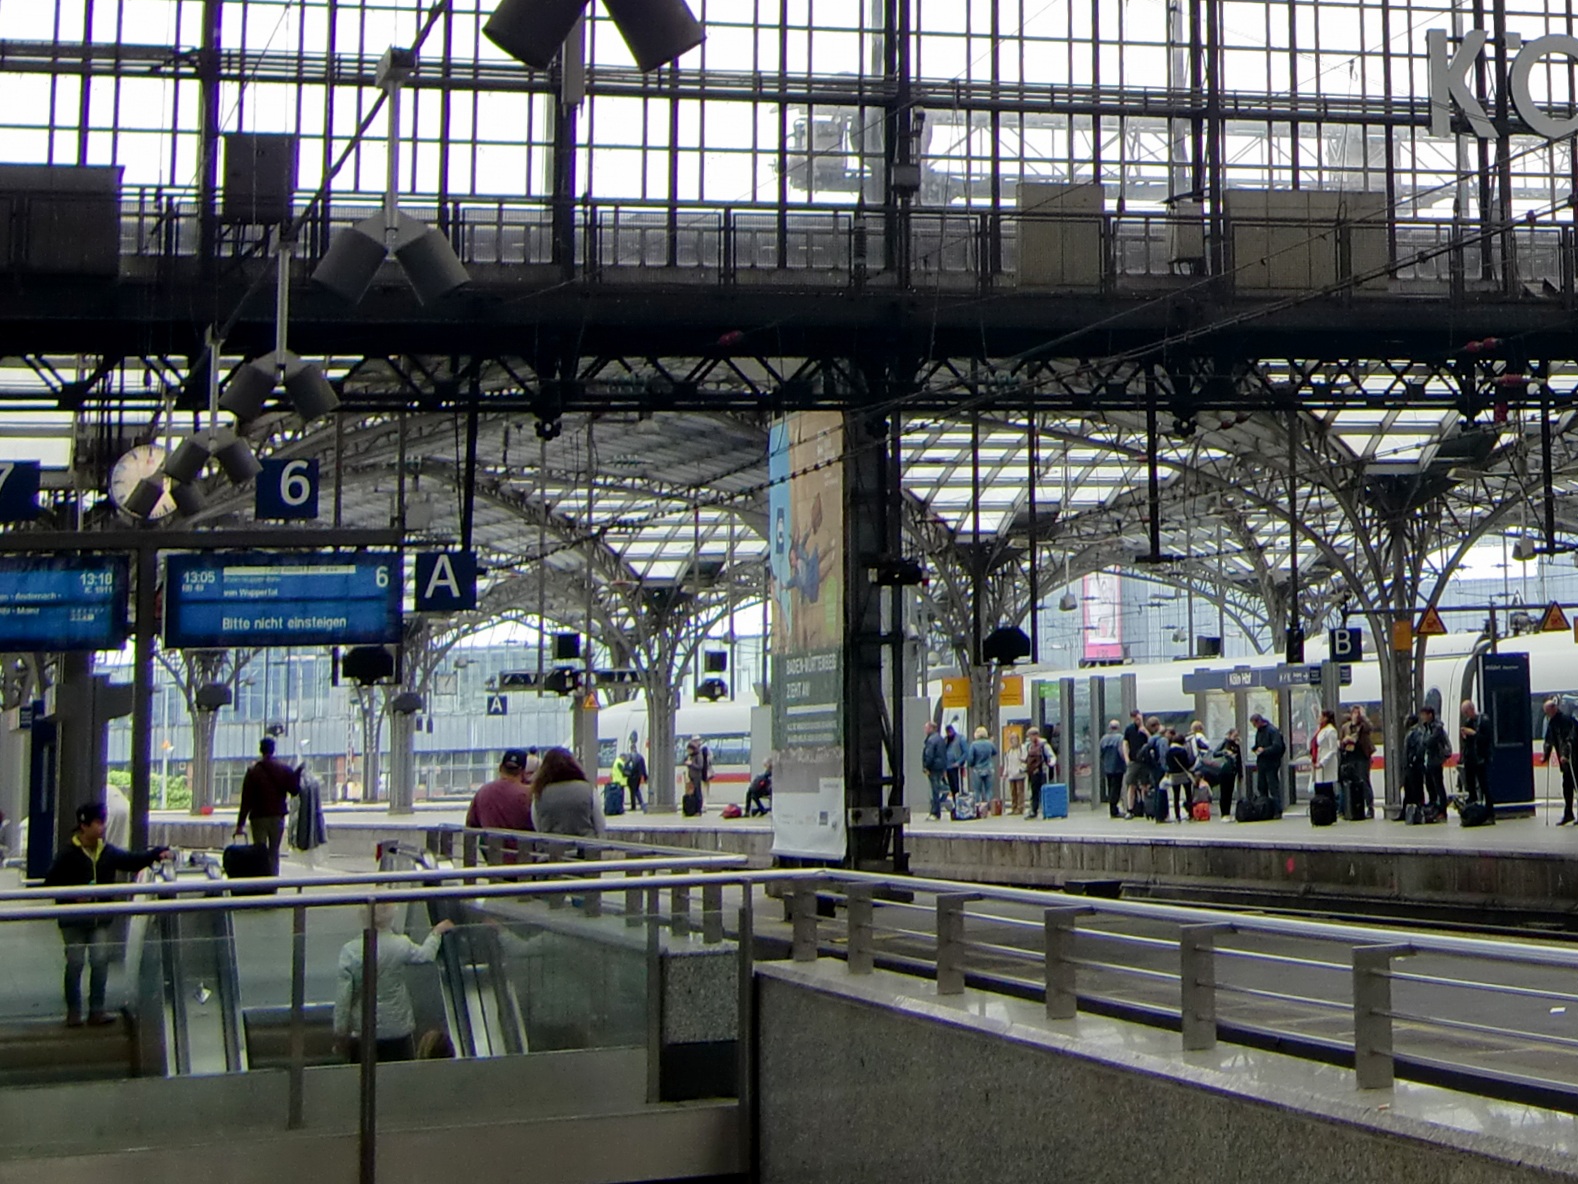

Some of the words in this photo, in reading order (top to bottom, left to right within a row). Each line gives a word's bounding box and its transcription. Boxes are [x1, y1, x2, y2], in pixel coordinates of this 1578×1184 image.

[279, 459, 312, 507] 6
[182, 571, 216, 584] 13:05
[375, 566, 389, 588] 6
[424, 554, 461, 599] A
[222, 617, 250, 630] Bitte
[254, 617, 284, 629] nicht
[287, 616, 347, 630] einsteigen
[1335, 629, 1351, 655] B
[490, 696, 503, 713] A
